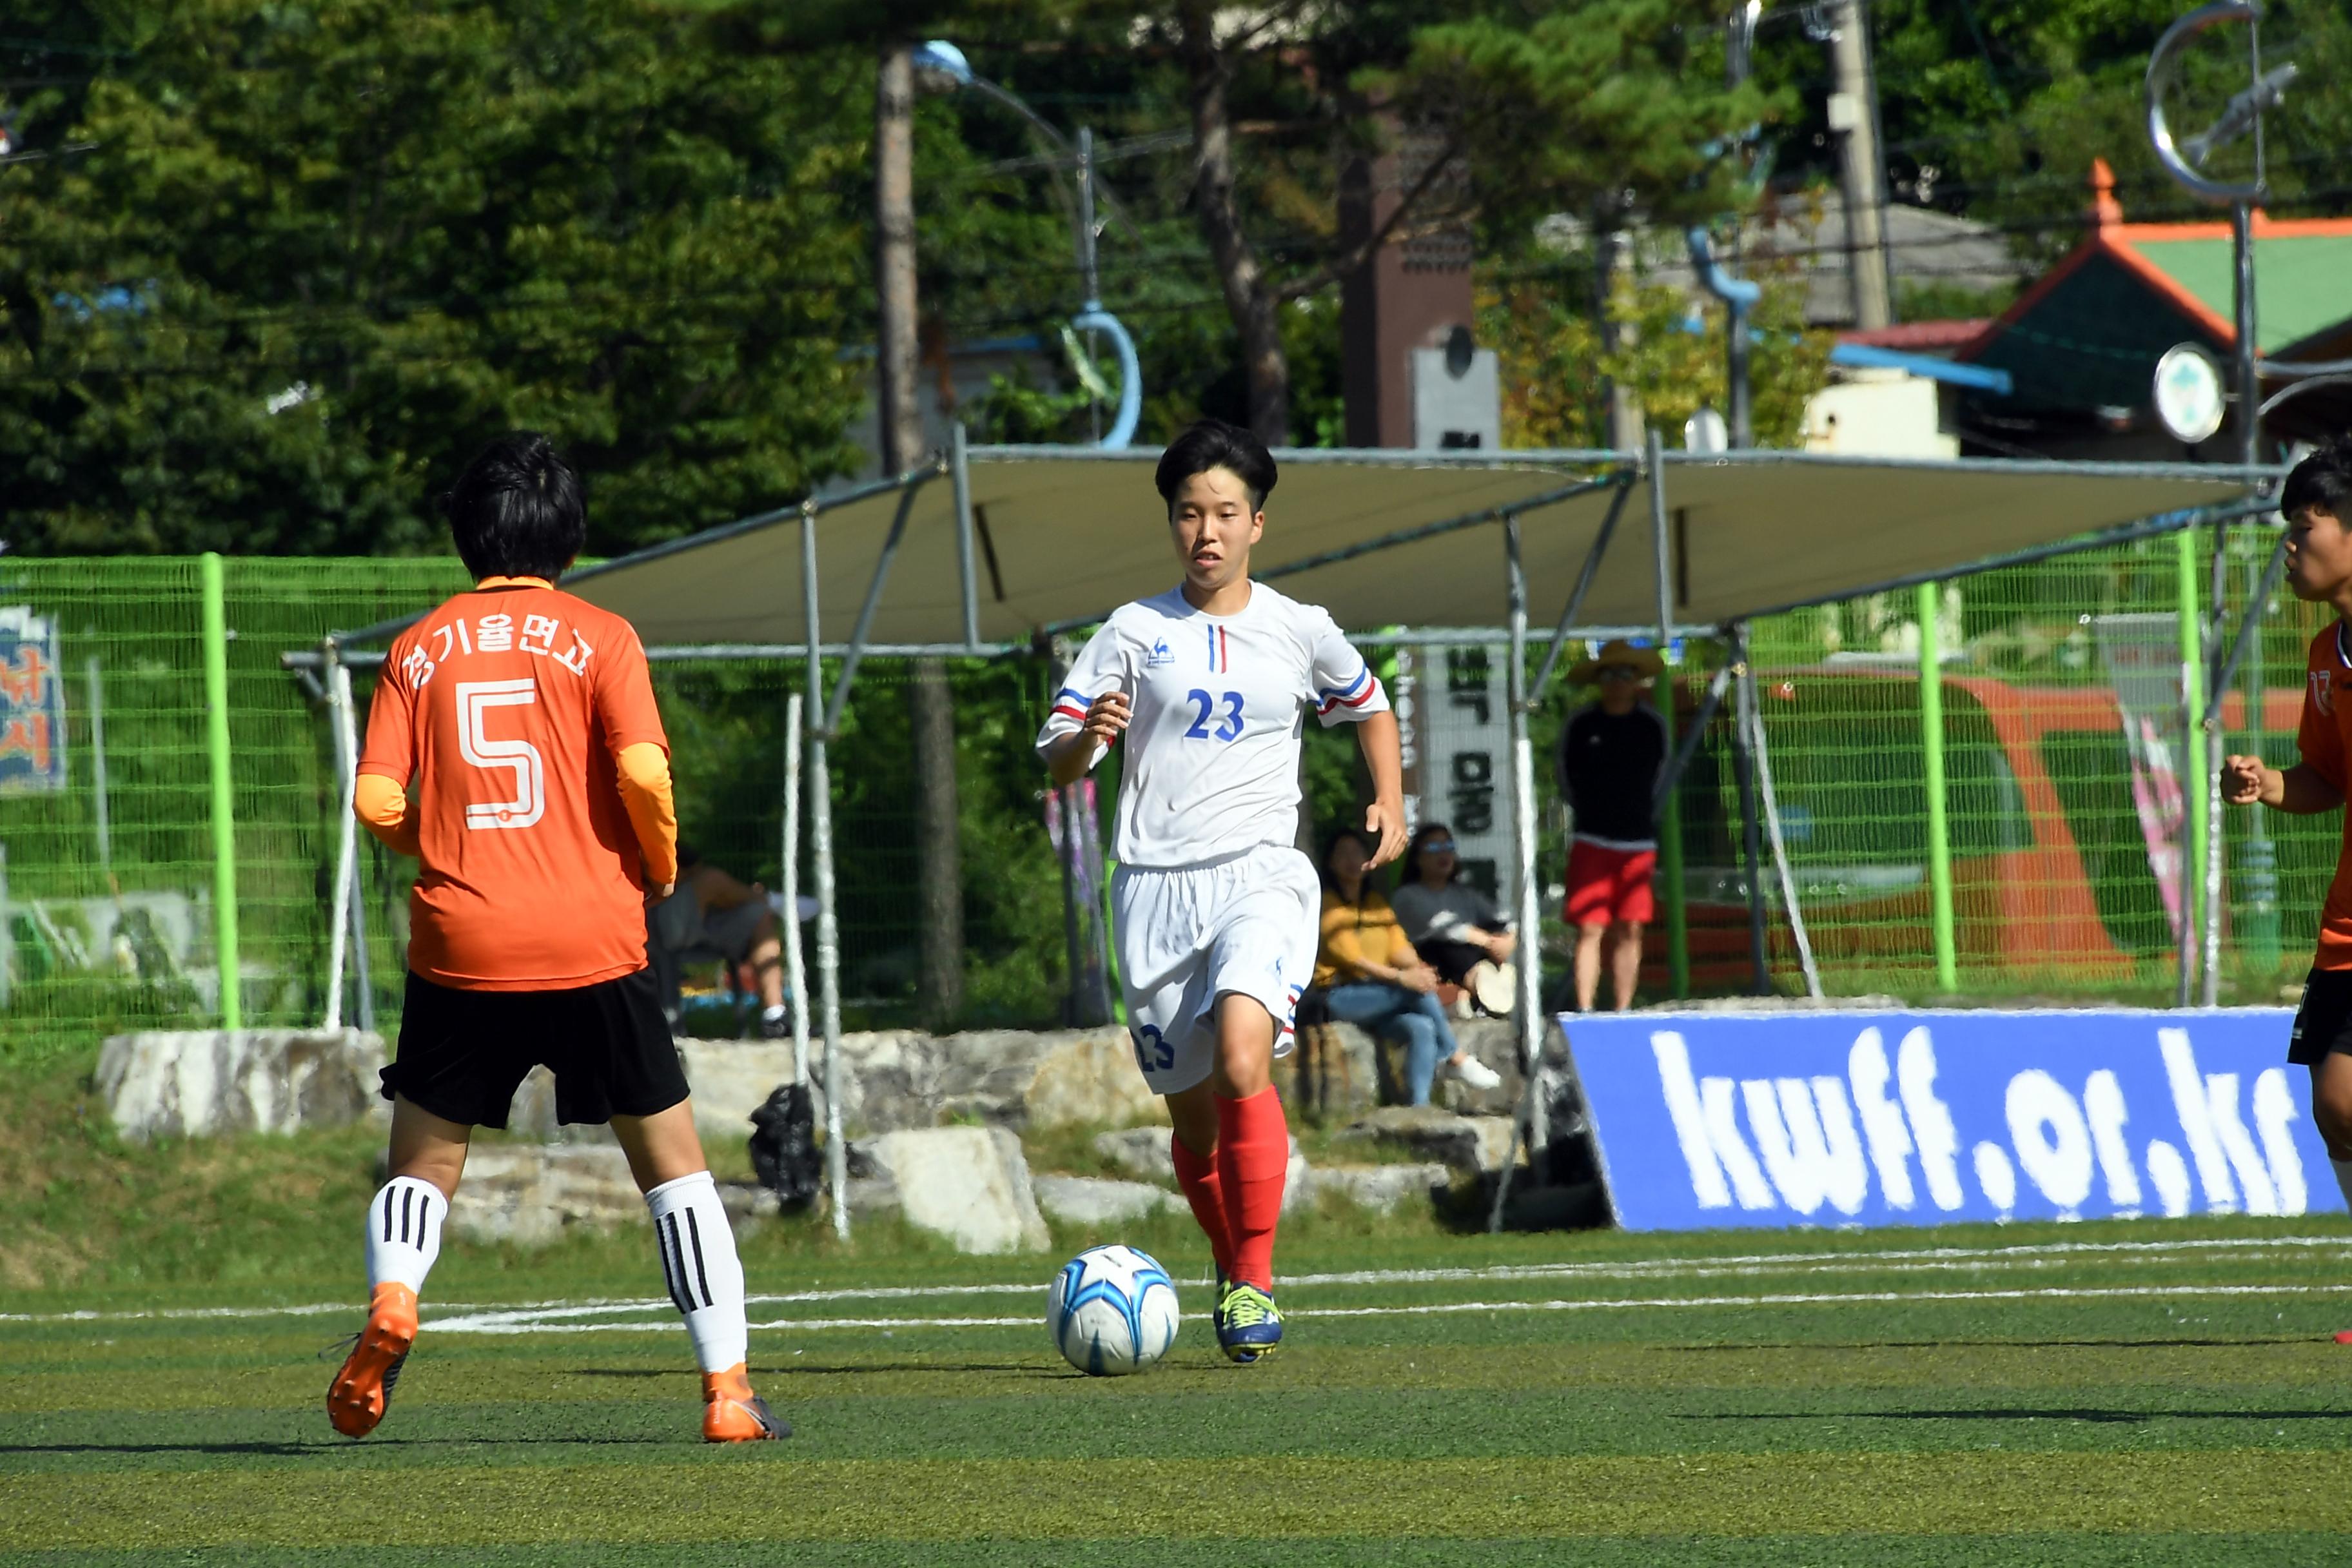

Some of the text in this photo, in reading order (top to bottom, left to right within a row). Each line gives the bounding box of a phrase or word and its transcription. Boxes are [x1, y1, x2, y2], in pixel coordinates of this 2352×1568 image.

[455, 678, 545, 829] 5
[1184, 689, 1244, 742] 23
[1650, 1026, 2307, 1217] kwff.or.kr
